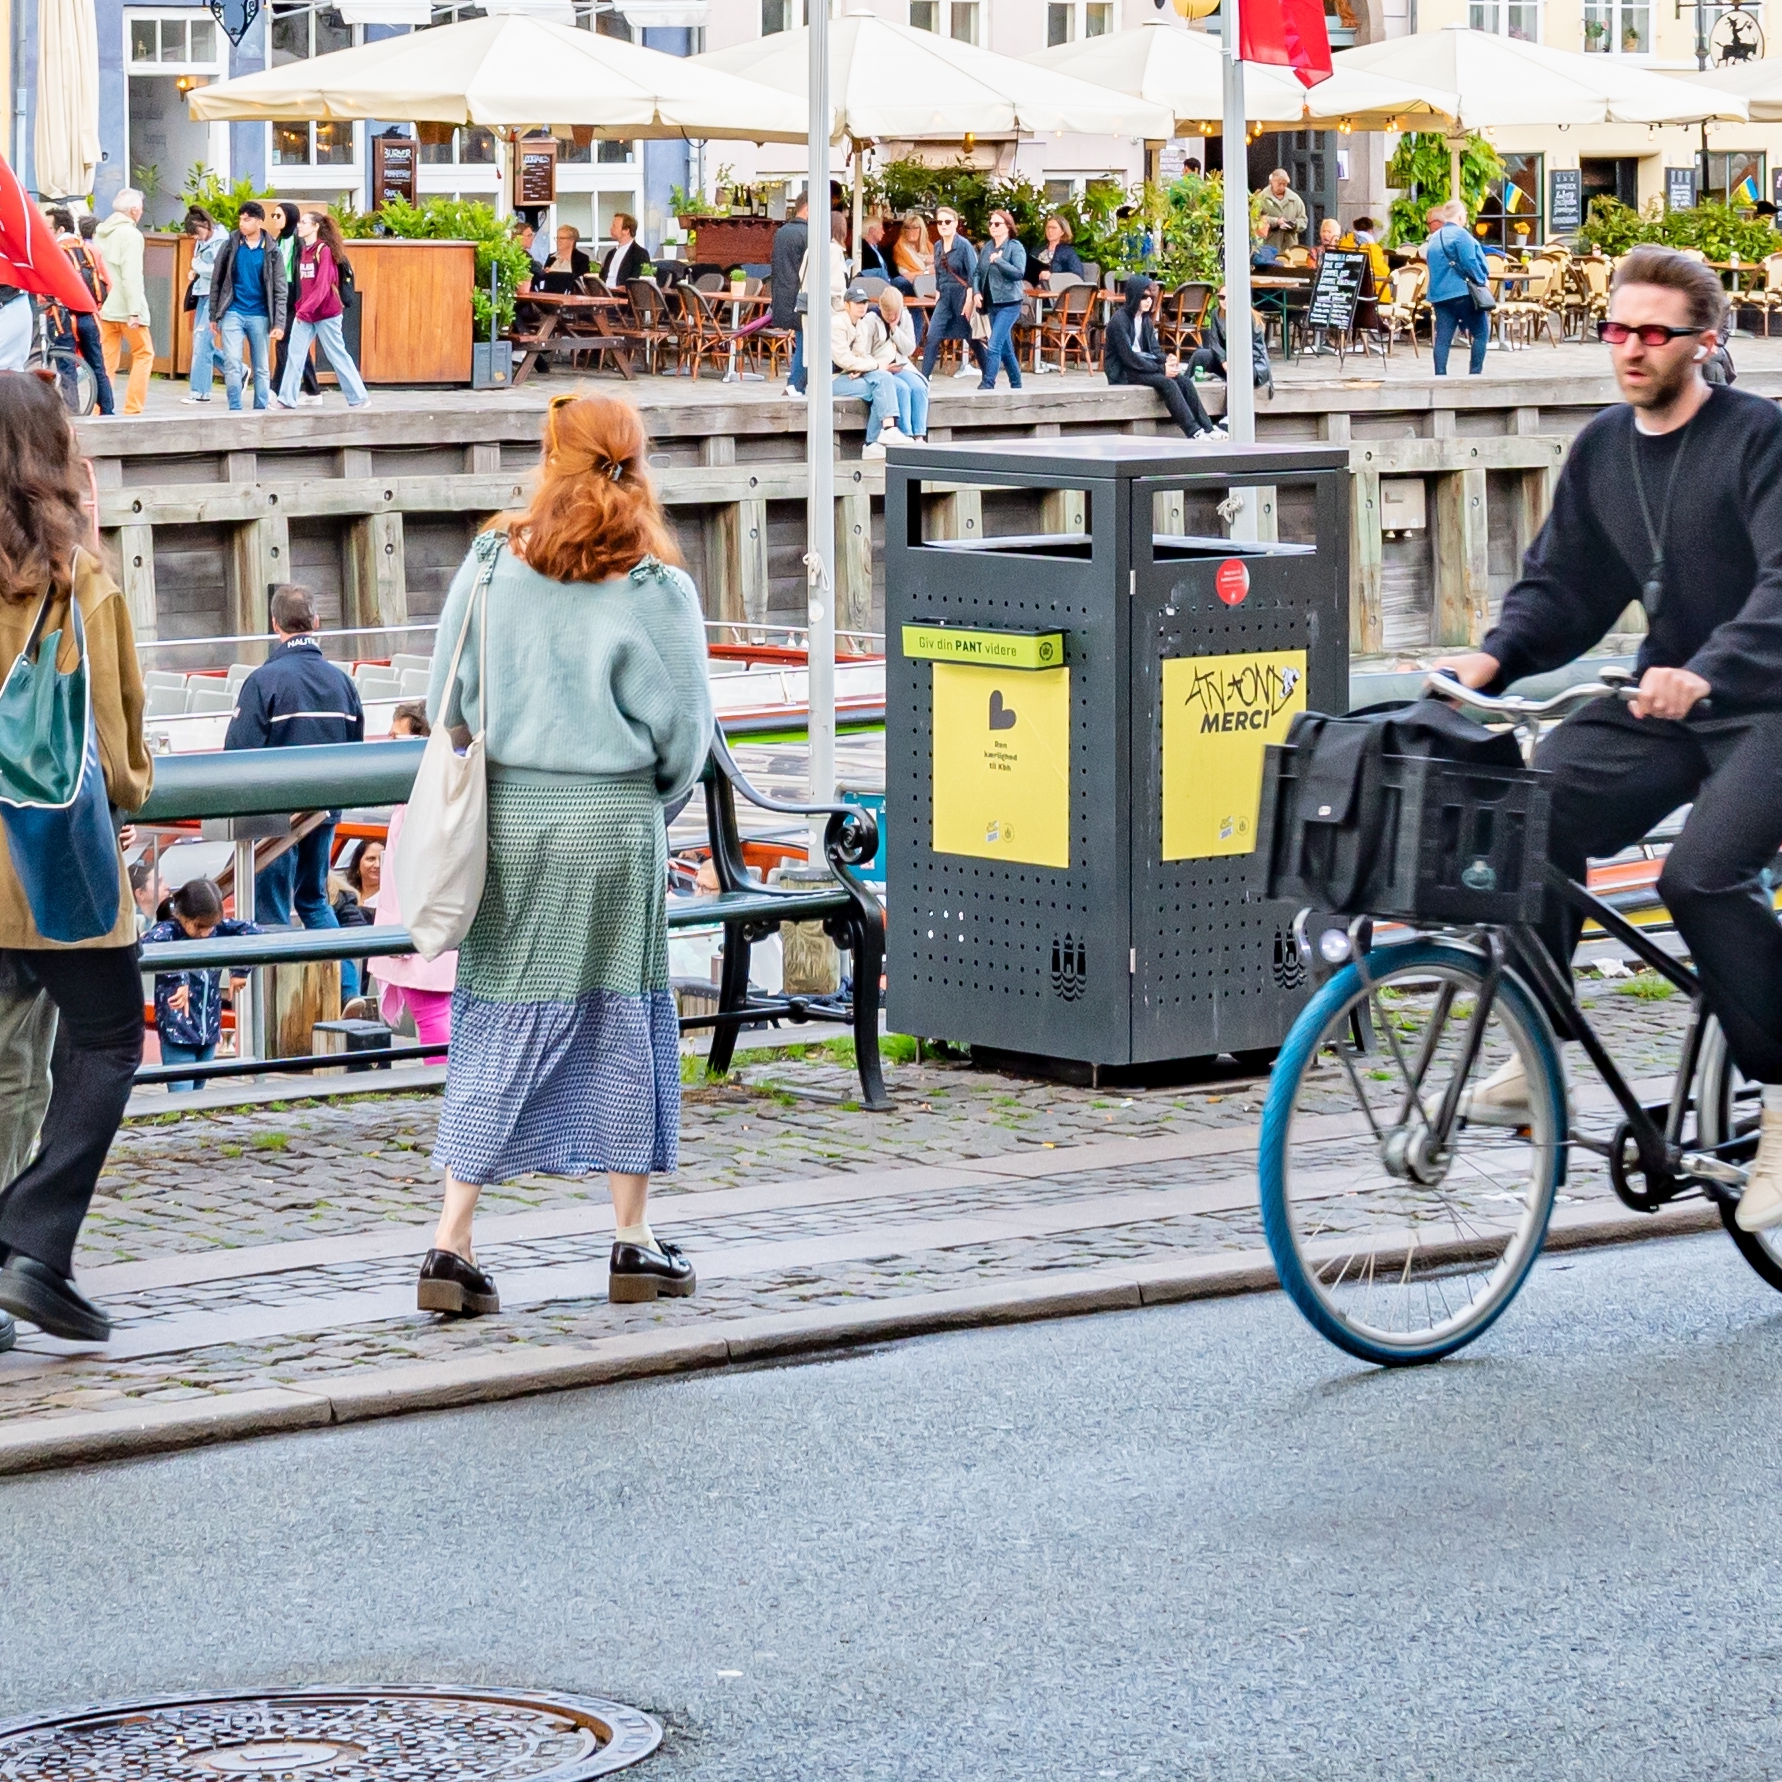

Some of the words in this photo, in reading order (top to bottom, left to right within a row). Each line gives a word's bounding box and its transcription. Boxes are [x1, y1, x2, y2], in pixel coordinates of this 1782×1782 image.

[919, 636, 934, 650] Giv
[937, 637, 953, 651] din
[955, 639, 982, 654] PANT
[984, 643, 1017, 657] videre
[1200, 709, 1269, 734] MERCI
